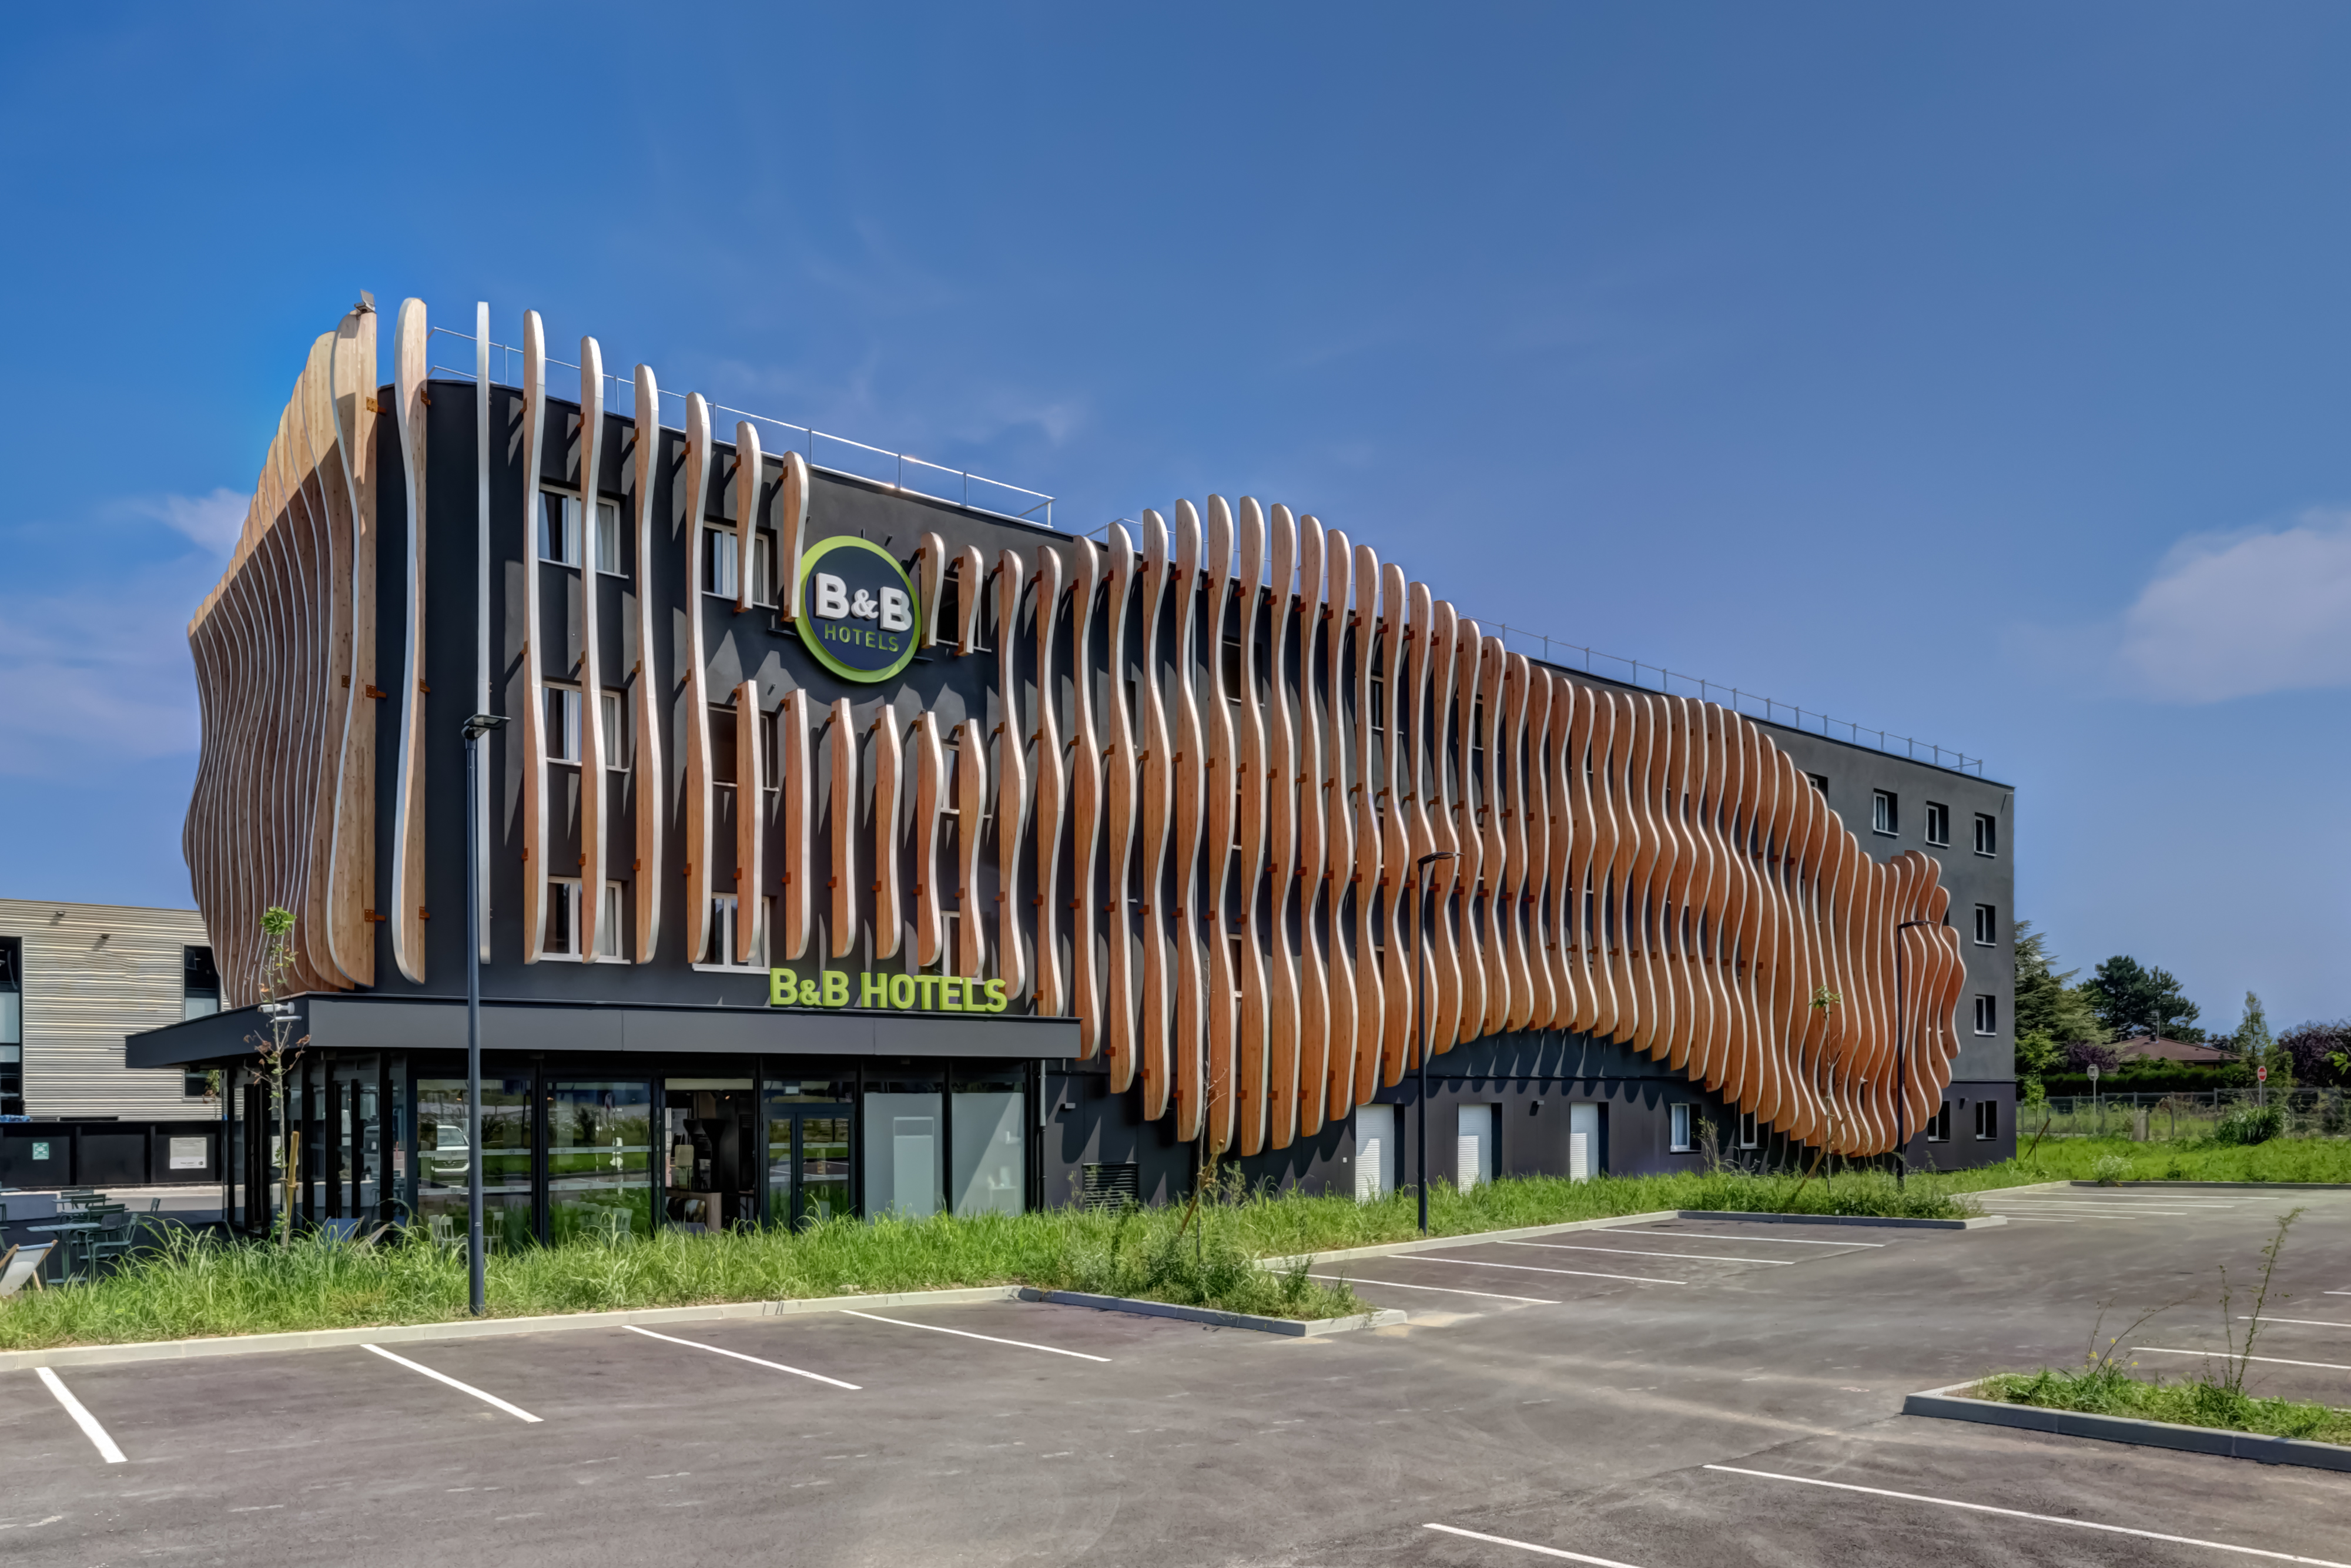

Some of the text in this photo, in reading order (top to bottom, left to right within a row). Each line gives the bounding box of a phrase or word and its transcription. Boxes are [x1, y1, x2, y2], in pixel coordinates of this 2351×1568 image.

[816, 572, 912, 632] B&B
[825, 624, 899, 652] HOTELS
[770, 968, 1007, 1012] B&B HOTELS
